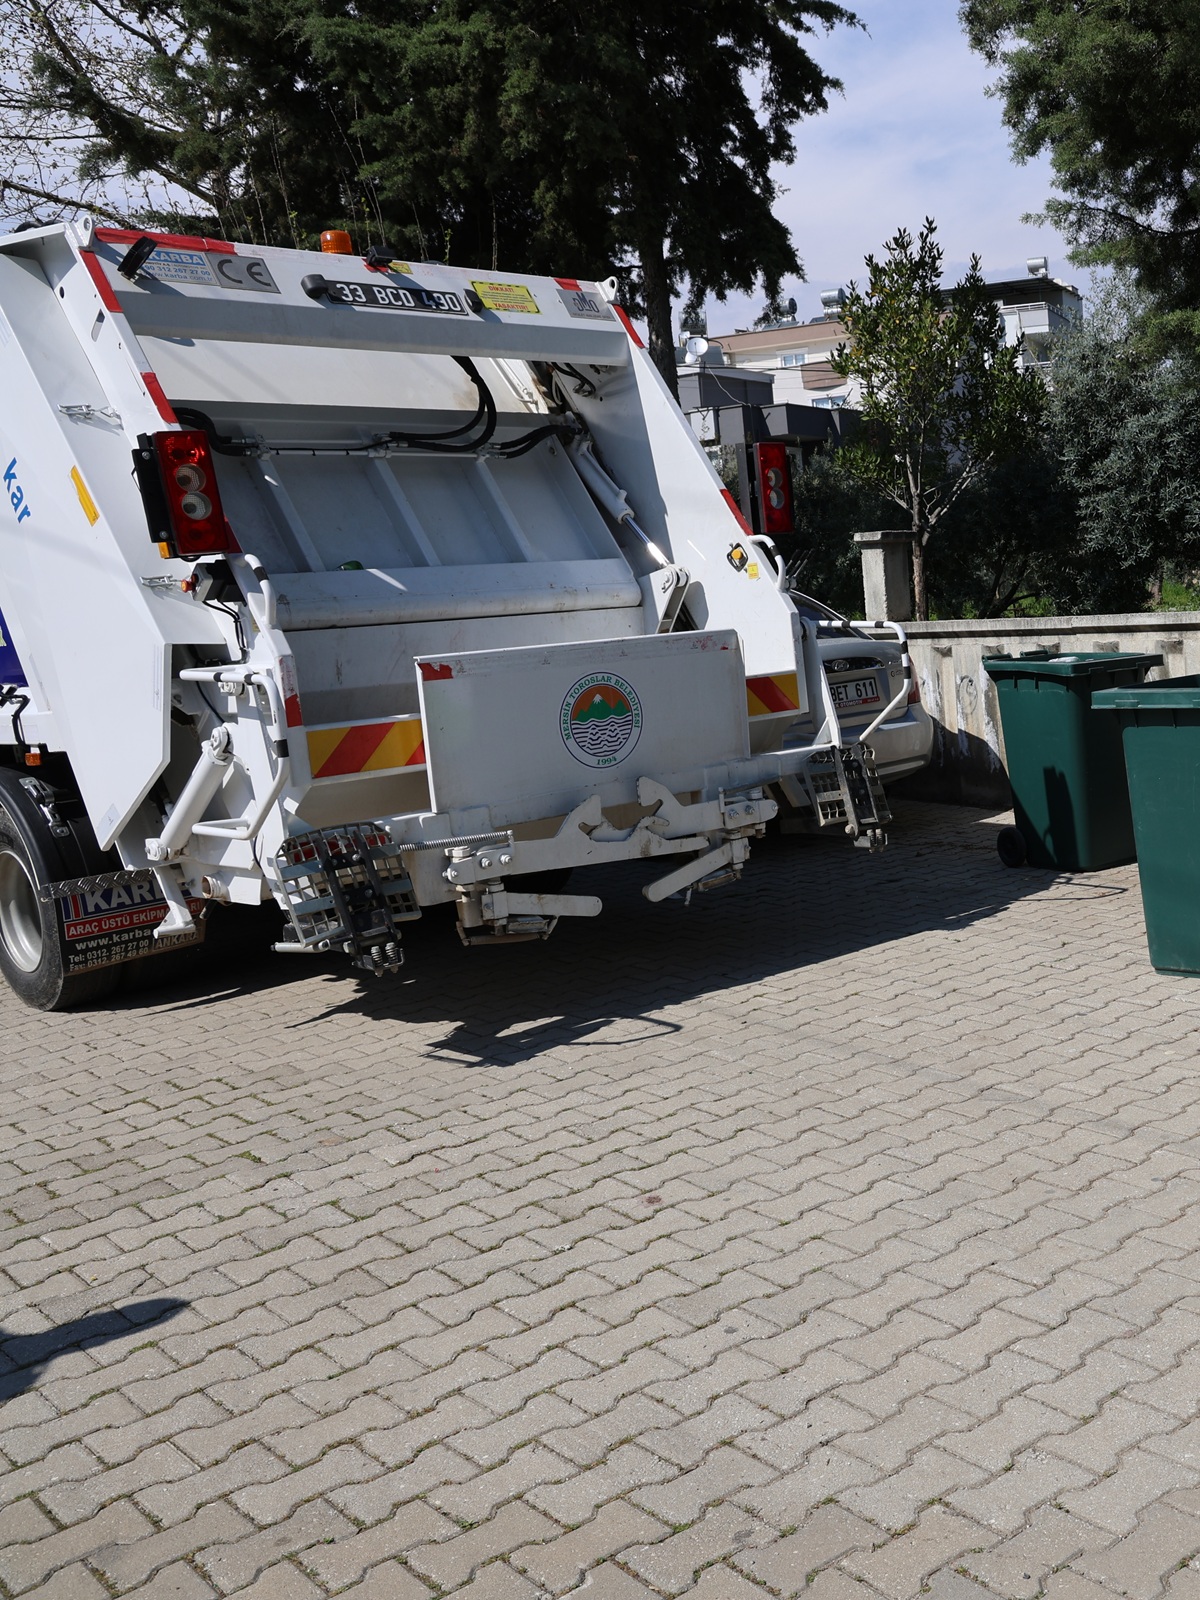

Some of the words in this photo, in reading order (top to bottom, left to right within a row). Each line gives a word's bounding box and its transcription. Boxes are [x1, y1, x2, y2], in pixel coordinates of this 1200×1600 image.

[149, 251, 203, 265] KARBA
[336, 283, 367, 303] 33
[372, 287, 416, 307] BCD
[421, 291, 462, 312] 490
[569, 675, 612, 700] TOROSLAR
[855, 680, 875, 698] 611
[68, 920, 99, 936] ARAÇ
[101, 914, 130, 930] ÜSTÜ
[68, 954, 85, 964] Tel:
[86, 949, 109, 961] 0312.
[111, 944, 126, 955] 267
[127, 942, 137, 951] 27
[139, 938, 149, 948] 00
